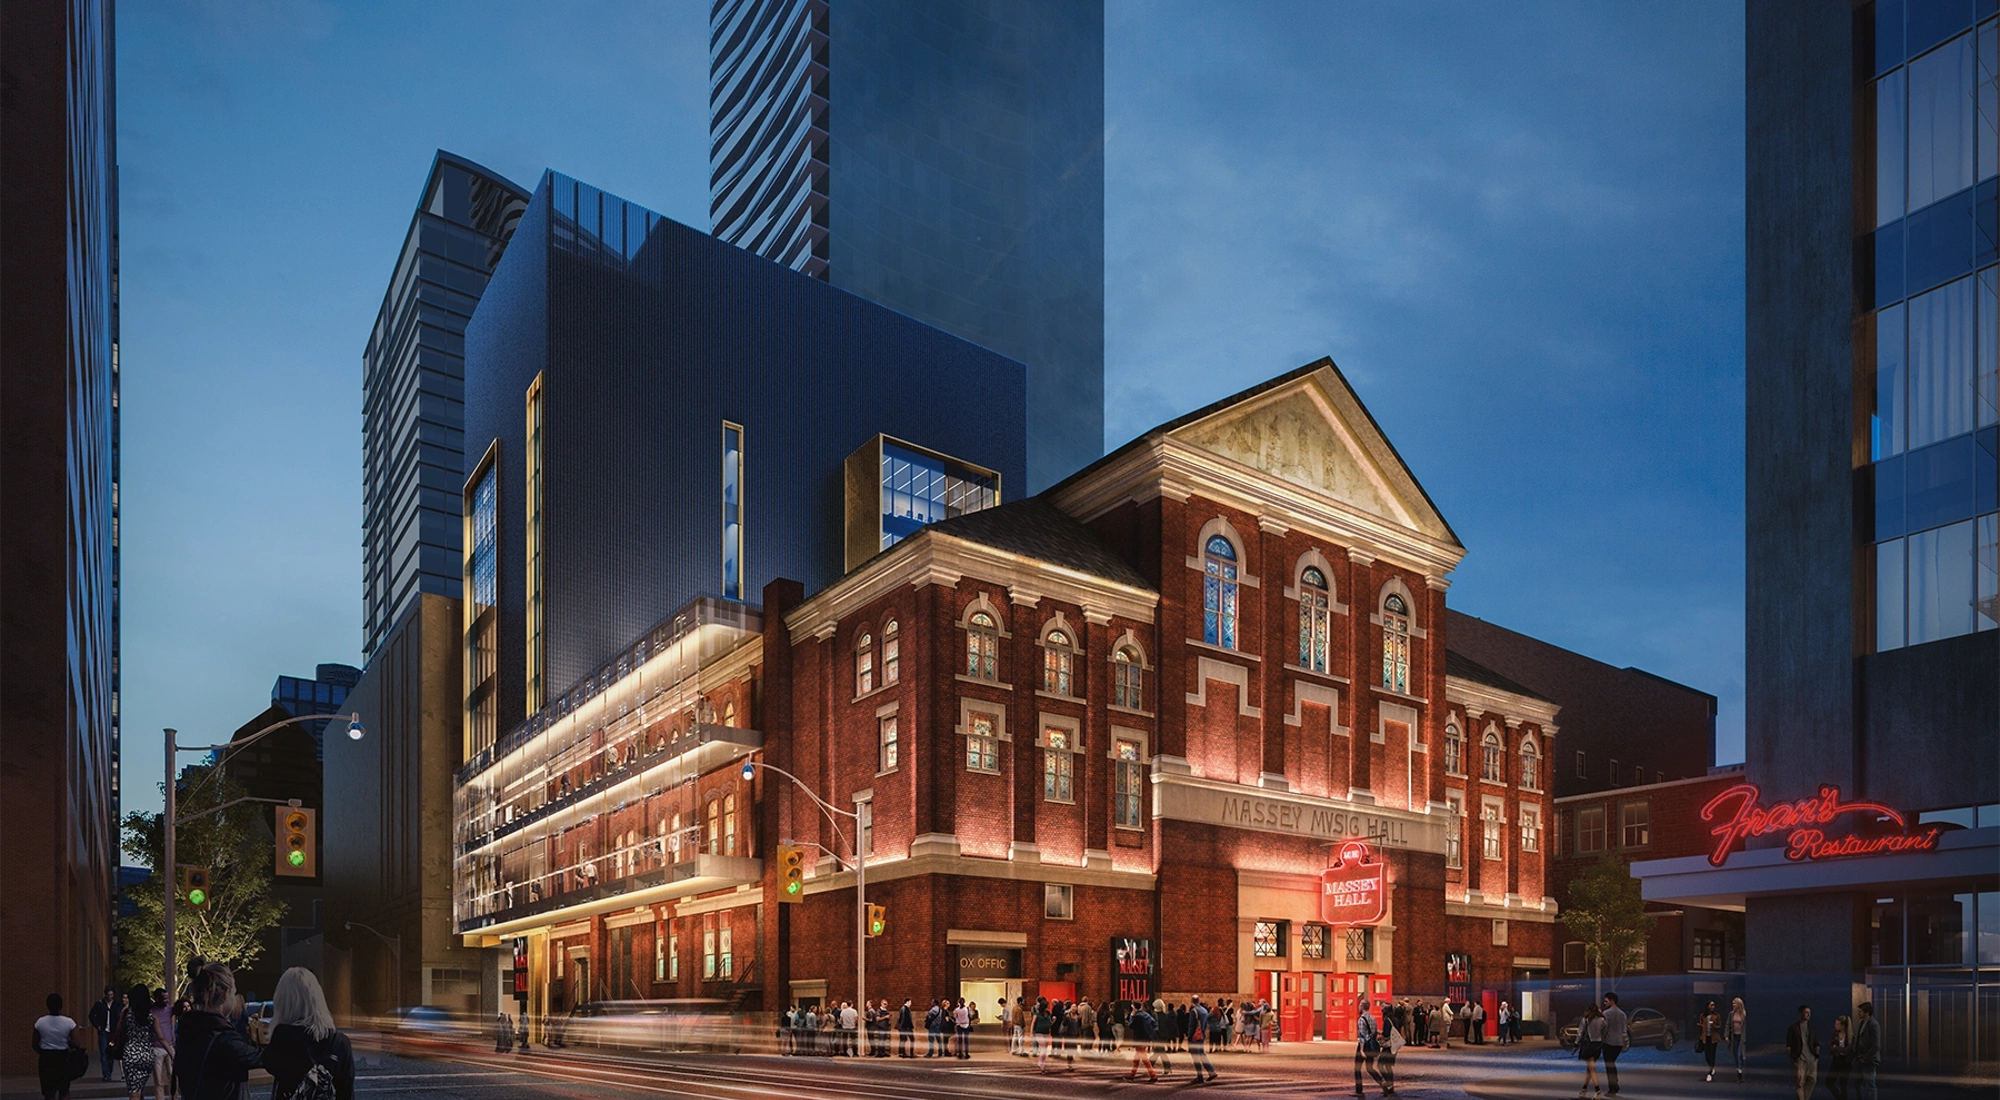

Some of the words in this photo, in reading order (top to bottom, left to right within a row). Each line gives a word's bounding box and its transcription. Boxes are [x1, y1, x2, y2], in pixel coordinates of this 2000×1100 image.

[1222, 797, 1302, 829] MASSEY
[1367, 818, 1408, 844] HALL
[1700, 783, 1842, 864] Fran's
[1789, 828, 1938, 860] Restaurant
[1325, 877, 1379, 895] MASSEY
[1334, 893, 1370, 907] HALL
[1120, 979, 1150, 1001] HALL
